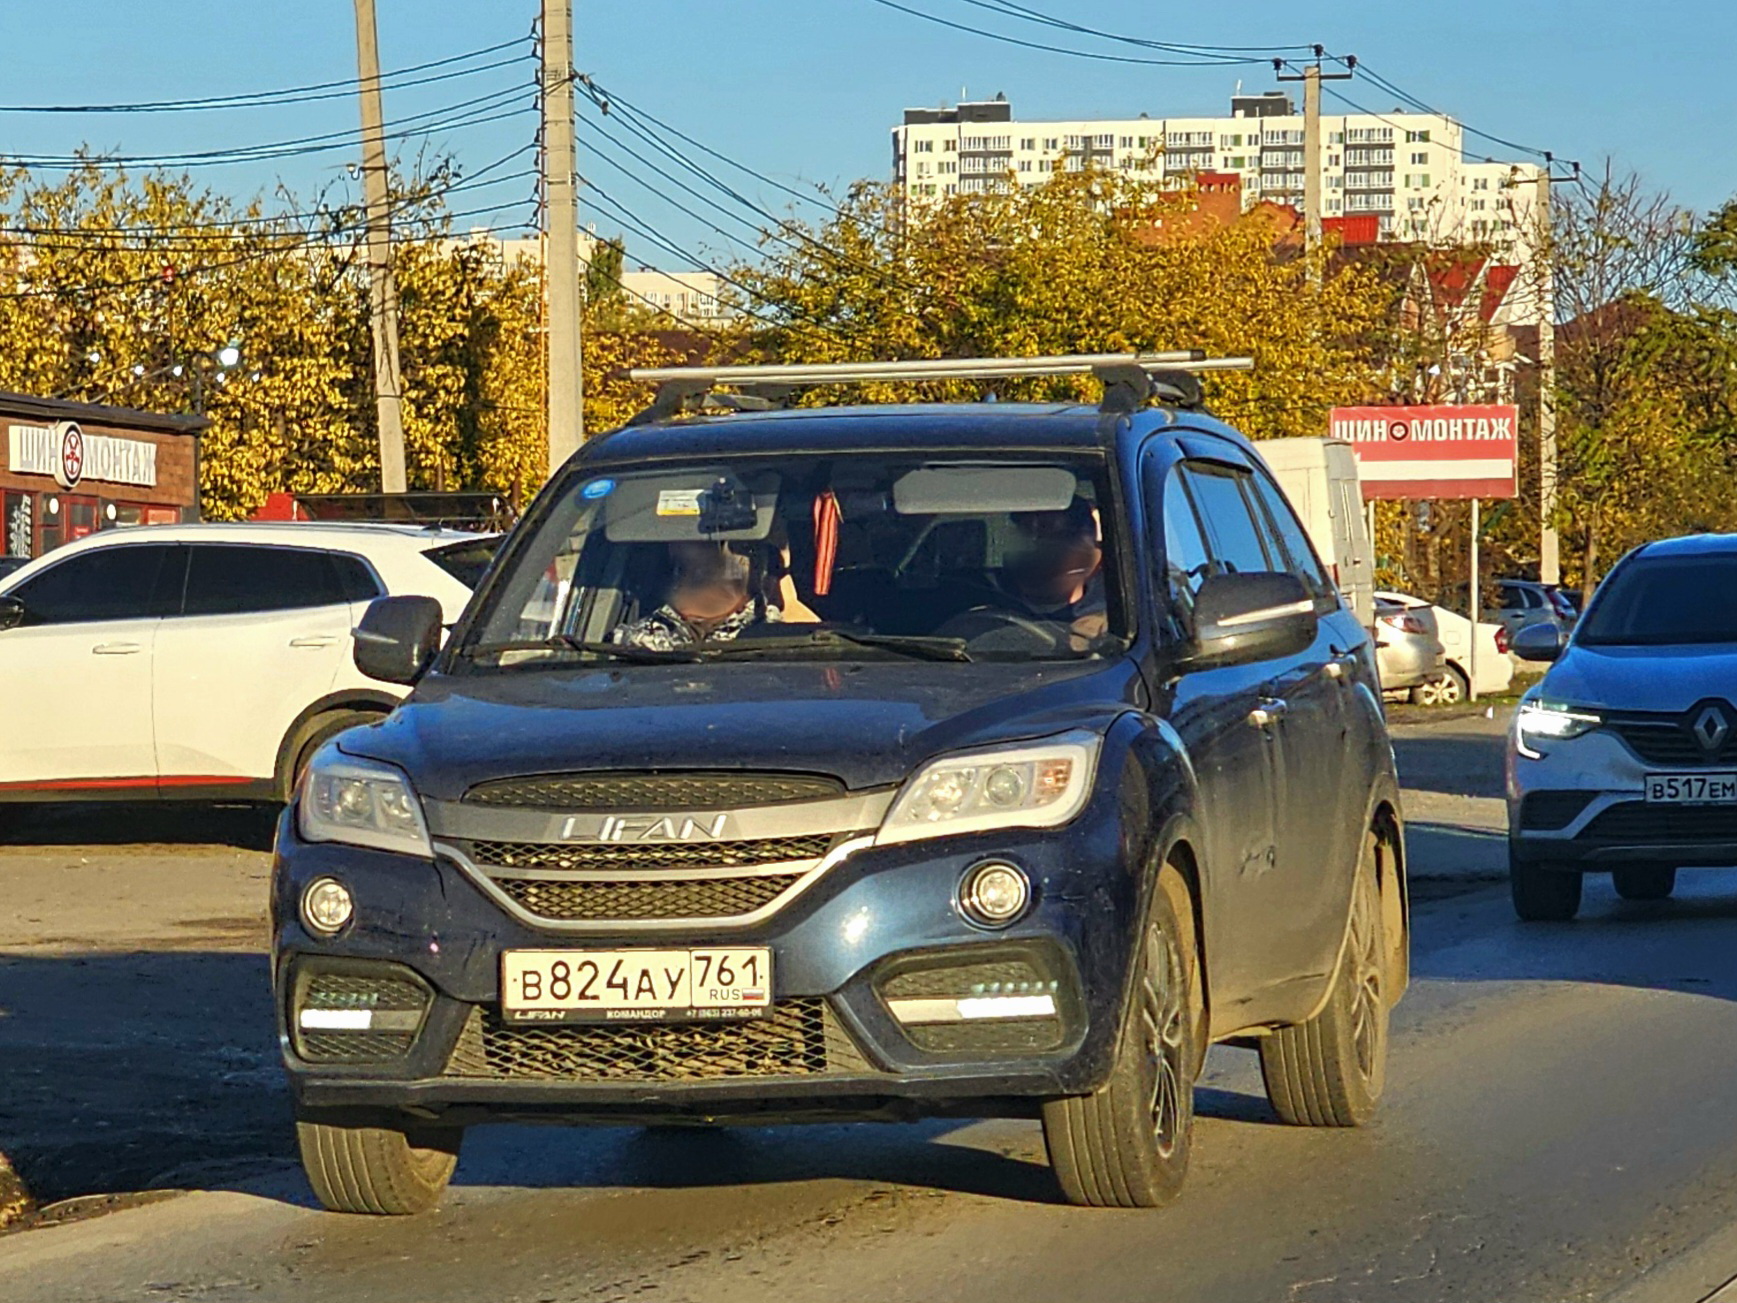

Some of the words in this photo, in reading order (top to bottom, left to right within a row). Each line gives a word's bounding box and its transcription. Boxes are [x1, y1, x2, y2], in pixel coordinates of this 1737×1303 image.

[1653, 778, 1735, 799] В517ЕМ
[559, 814, 727, 841] LIFAN
[695, 955, 758, 987] 761
[709, 988, 740, 1000] RUS
[514, 1010, 566, 1019] LIFAN
